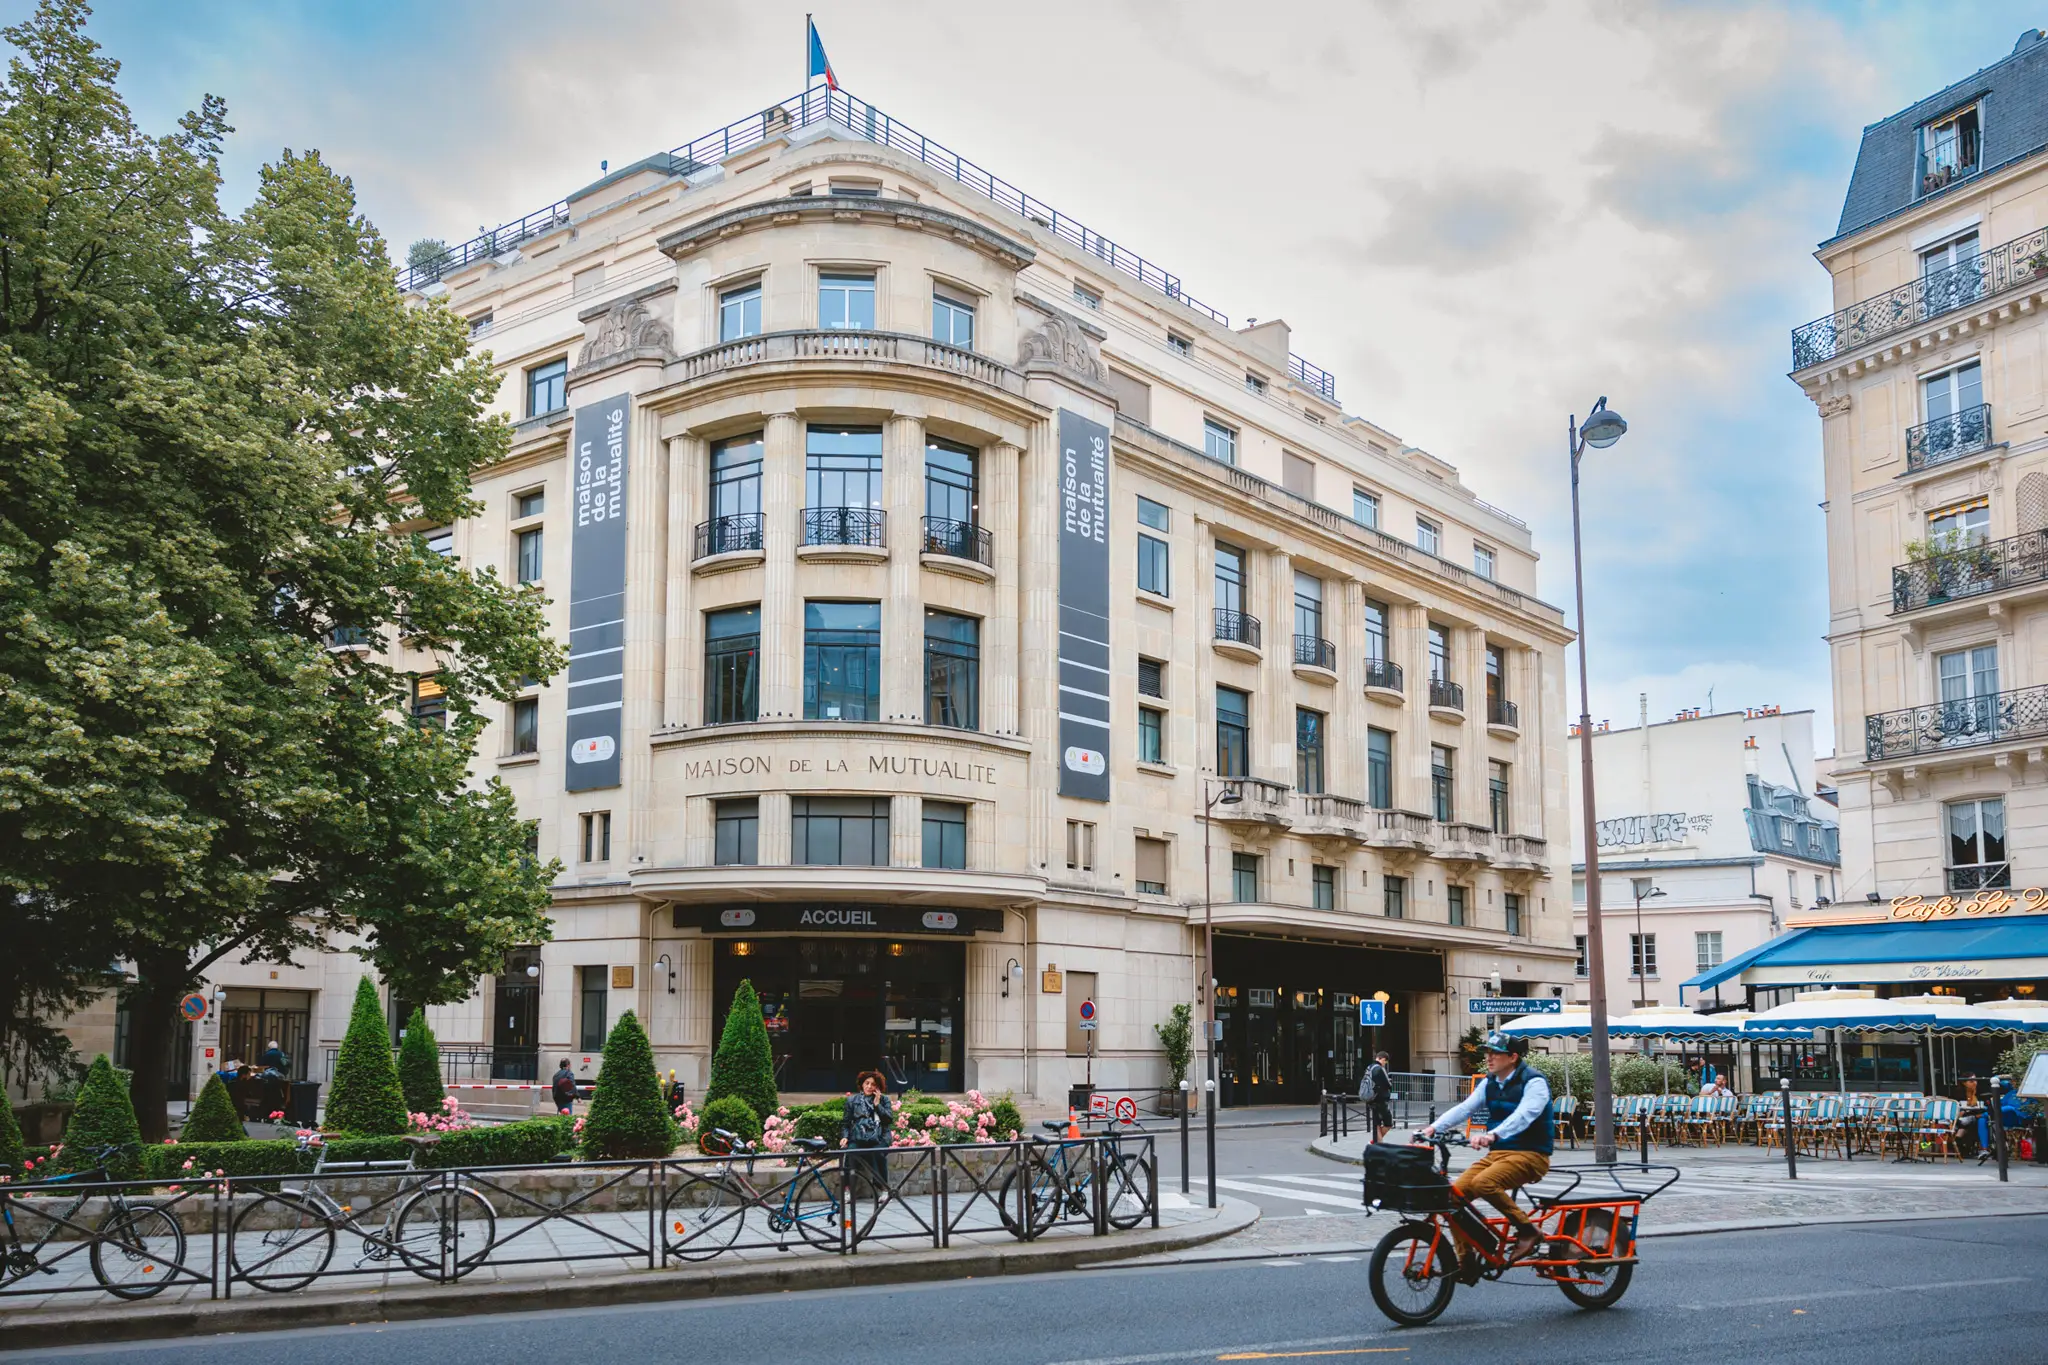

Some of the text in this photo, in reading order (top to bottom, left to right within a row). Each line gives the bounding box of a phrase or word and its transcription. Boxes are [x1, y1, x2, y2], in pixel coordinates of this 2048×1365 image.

[576, 441, 592, 527] maison
[606, 408, 623, 519] mutualité
[1062, 448, 1077, 534] maison
[1089, 436, 1105, 544] mutualité
[591, 465, 607, 522] de la
[1077, 482, 1091, 538] de la
[685, 755, 772, 780] MAISON
[789, 759, 812, 773] DE
[826, 759, 849, 773] LA
[800, 909, 877, 926] ACCUEIL
[1890, 894, 1962, 922] Café
[1964, 890, 2017, 915] St
[1807, 969, 1833, 981] Café
